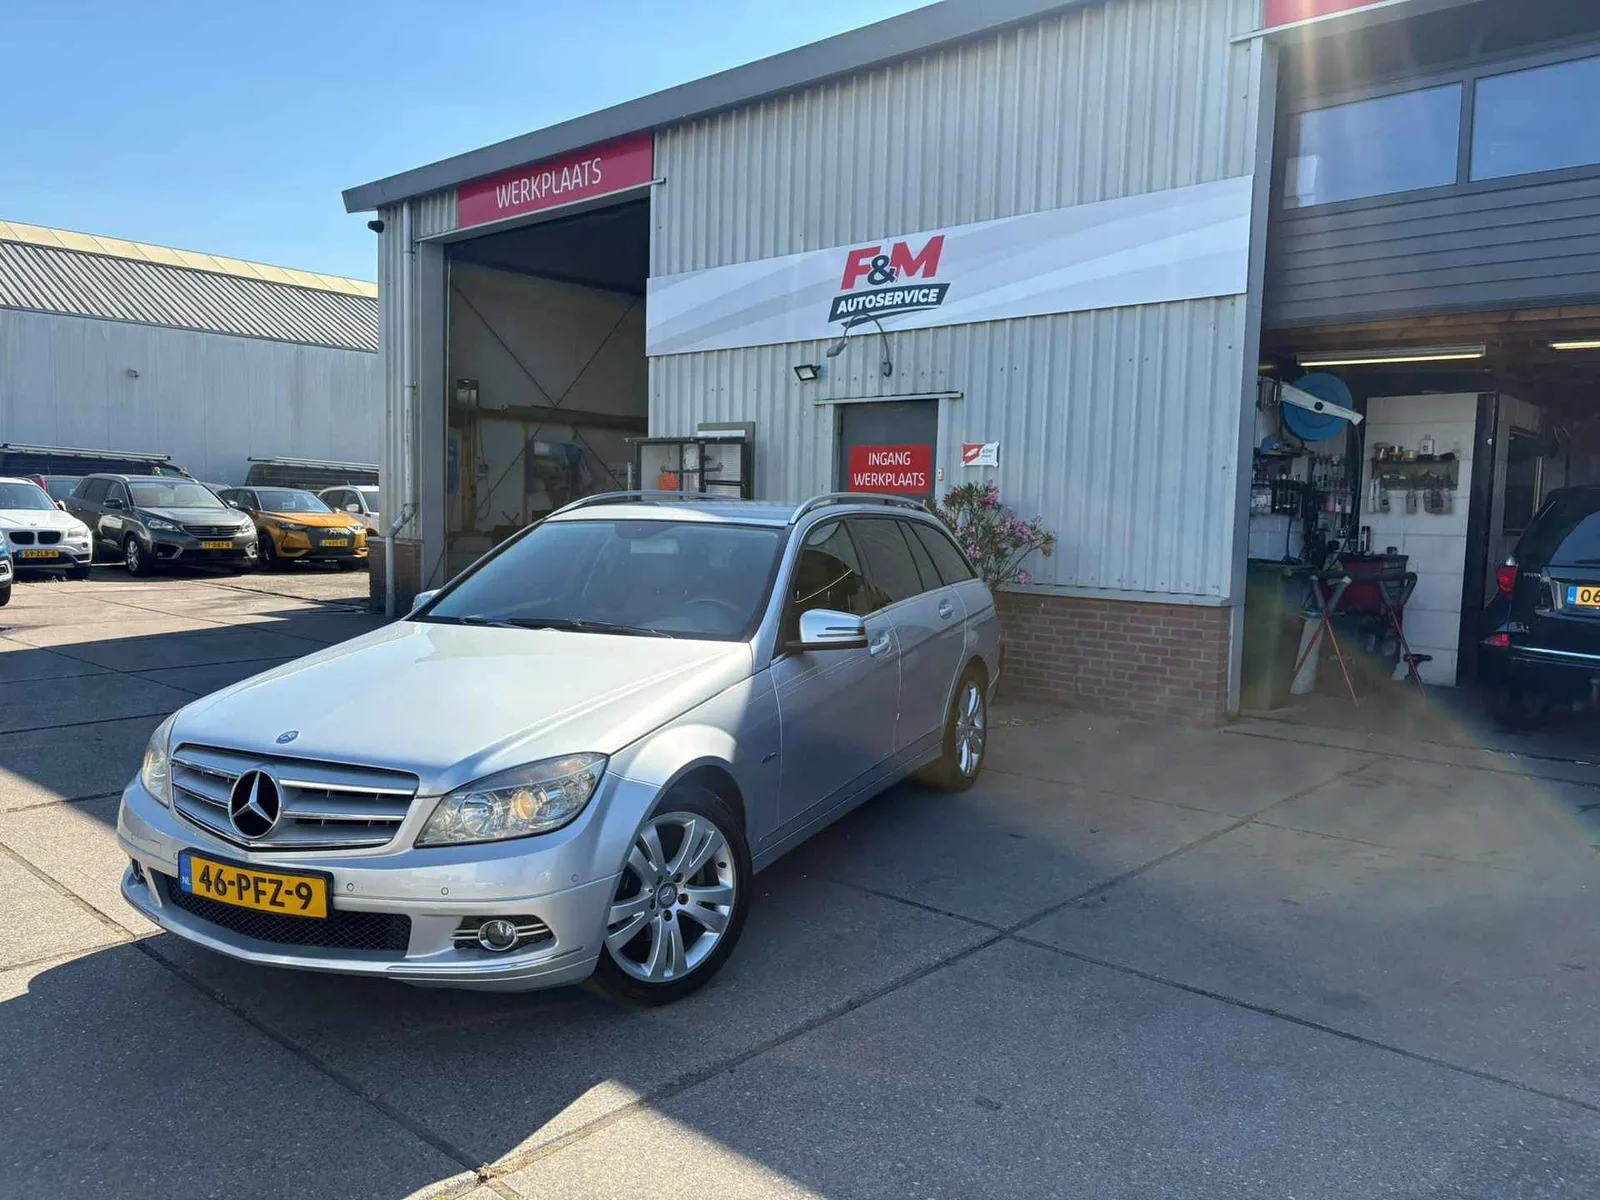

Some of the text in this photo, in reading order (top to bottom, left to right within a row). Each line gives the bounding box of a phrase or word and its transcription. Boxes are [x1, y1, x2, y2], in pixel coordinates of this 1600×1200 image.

[496, 157, 602, 209] WERKPLAATS
[840, 235, 946, 291] F&M
[836, 288, 939, 315] AUTOSERVICE
[868, 451, 911, 466] INGANG
[854, 471, 926, 487] WERKPLAATS
[199, 865, 313, 910] 46-PFZ-9
